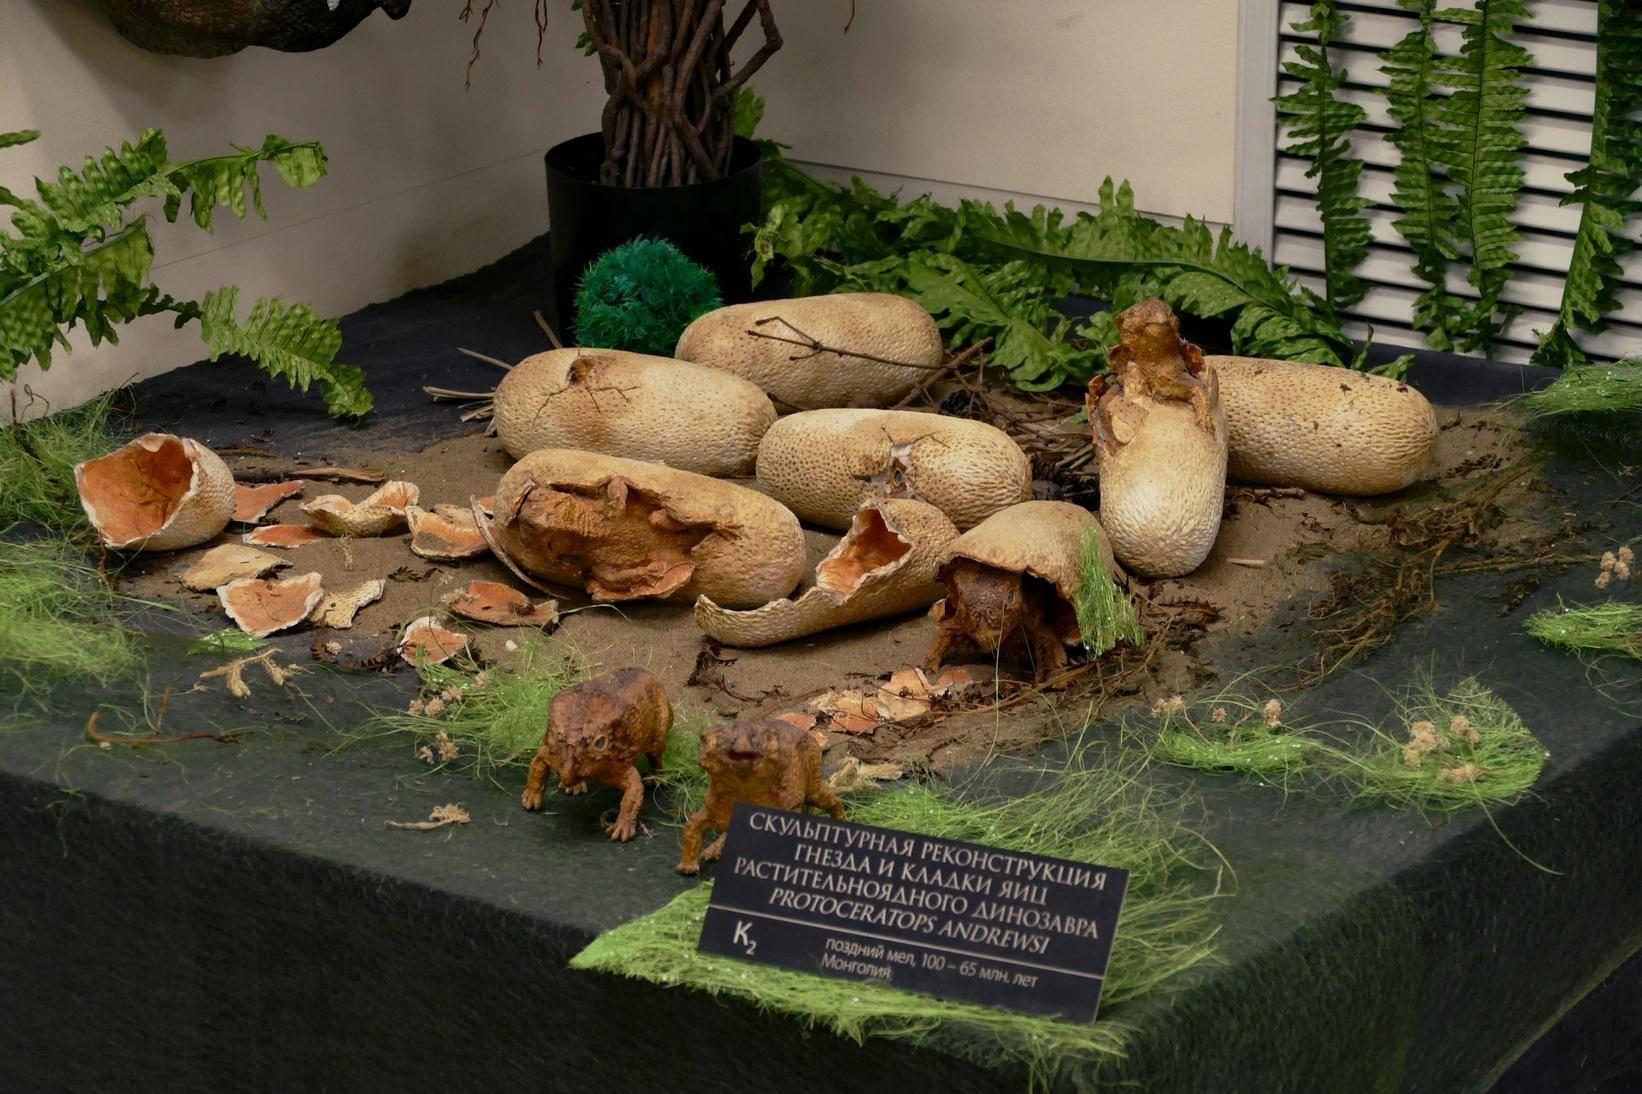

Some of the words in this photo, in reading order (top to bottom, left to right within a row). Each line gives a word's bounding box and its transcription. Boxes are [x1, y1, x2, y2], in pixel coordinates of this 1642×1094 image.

[749, 813, 914, 857] СКУЛЬПТУРНАЯ
[920, 843, 1106, 891] РЕКОНСТРУКЦИЯ
[795, 844, 871, 874] ГНЕЗДА
[879, 860, 894, 878] И
[901, 863, 992, 895] КЛАДКИ
[998, 881, 1047, 905] ЯИЦ
[734, 858, 968, 915] РАСТИТЕЛЬНОЯДНОГО
[972, 900, 1099, 939] ДИНОЗАВРА
[769, 888, 937, 934] PROTOCERATOPS
[939, 924, 1050, 955] ANDREWSI
[821, 955, 891, 979] Монголия
[826, 938, 884, 959] поздний
[887, 950, 916, 967] мел,
[922, 954, 945, 971] 100
[959, 962, 977, 977] 65
[979, 967, 1010, 984] млн.
[1013, 974, 1038, 989] лет
